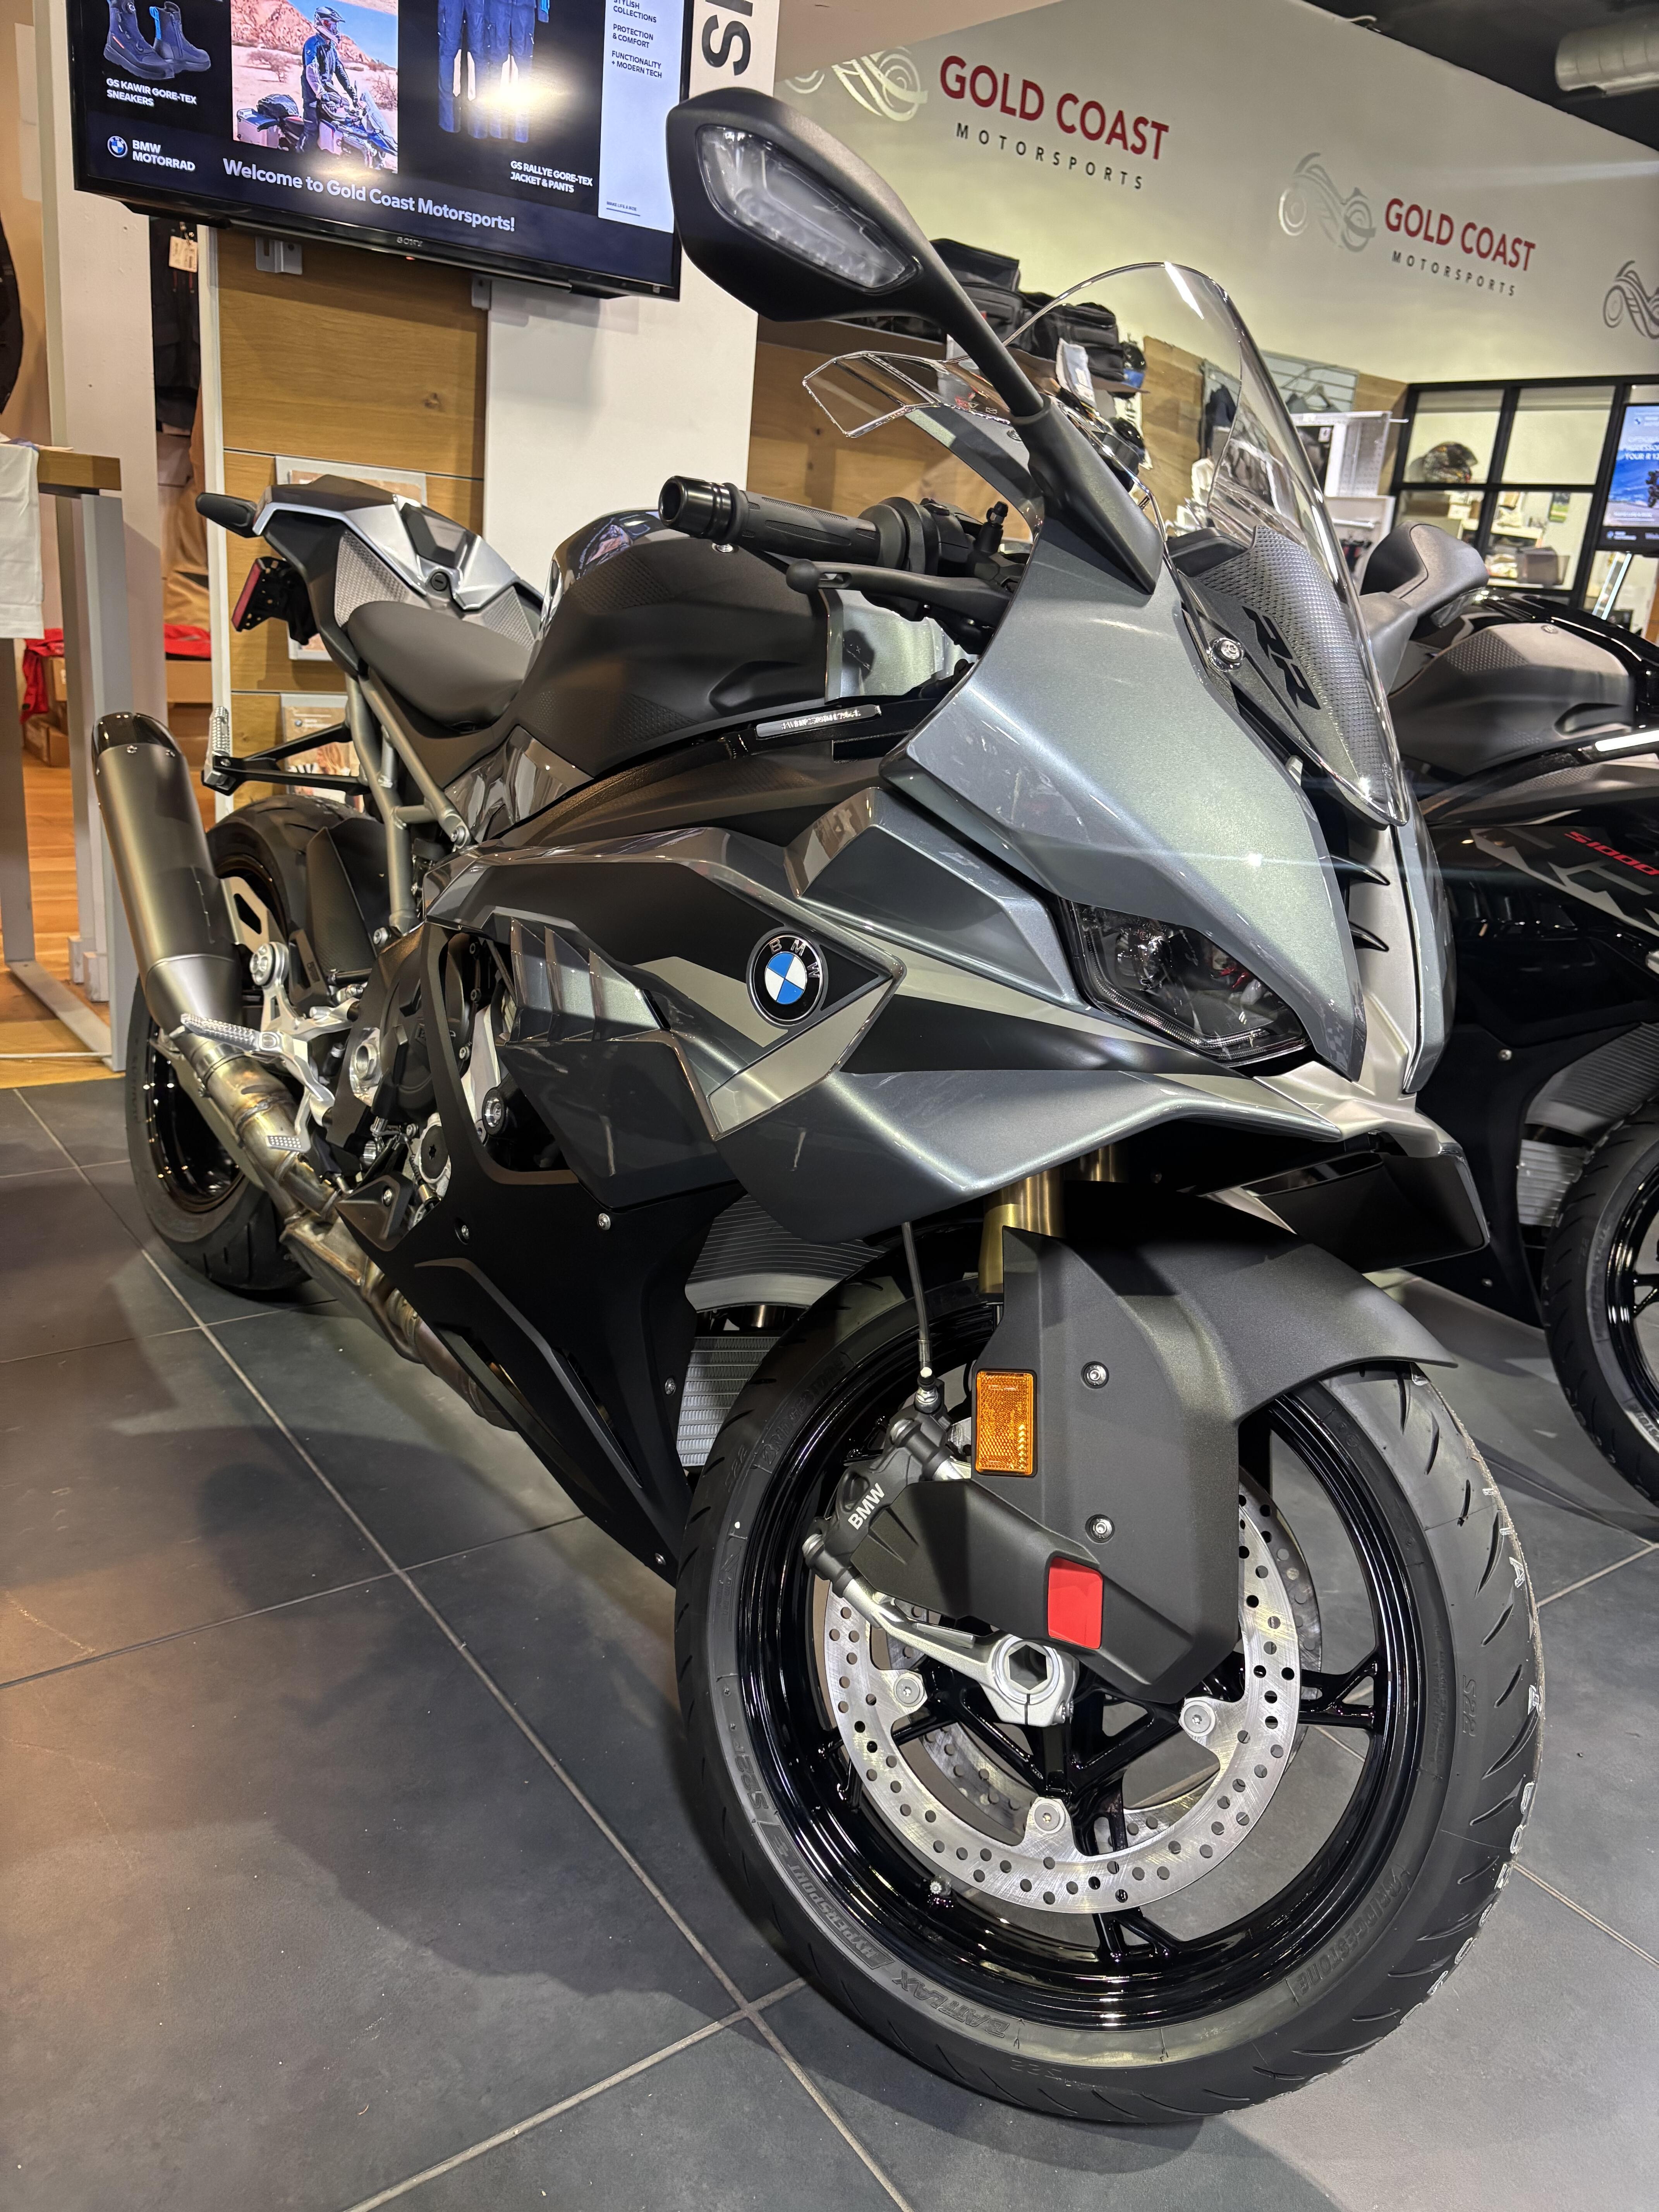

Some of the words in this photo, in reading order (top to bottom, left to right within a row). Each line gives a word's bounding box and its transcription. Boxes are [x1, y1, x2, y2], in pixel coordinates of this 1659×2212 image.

[613, 6, 657, 23] COLLECTIONS
[613, 24, 654, 40] PROTECTION
[618, 34, 649, 49] COMFORT
[612, 50, 661, 69] FUNCTIONALITY
[617, 61, 644, 74] MODERN
[646, 68, 662, 78] TECH
[106, 78, 120, 88] GS
[120, 80, 151, 96] KAWIR
[151, 88, 197, 105] GORE-TEX
[106, 89, 155, 107] SNEAKERS
[940, 55, 1044, 122] GOLD
[1056, 93, 1170, 160] COAST
[132, 139, 161, 154] BMW
[956, 122, 1144, 190] MOTORSPORTS
[132, 151, 196, 172] MOTORRAD
[510, 160, 523, 170] GS
[523, 163, 553, 177] RALLYE
[553, 170, 593, 187] GORE-TEX
[510, 172, 541, 186] JACKET
[542, 179, 548, 187] &
[549, 180, 575, 193] PANTS
[223, 158, 302, 189] Welcome
[305, 176, 324, 192] to
[326, 180, 366, 201] Gold
[369, 188, 415, 211] Coast
[417, 198, 515, 232] Motorsports!
[397, 236, 423, 247] SONY
[1385, 198, 1454, 246] GOLD
[1461, 222, 1536, 272] COAST
[1392, 251, 1516, 297] MOTORSPORTS
[769, 939, 821, 978] BMW
[847, 1482, 886, 1530] BMW
[1462, 1675, 1477, 1737] S22
